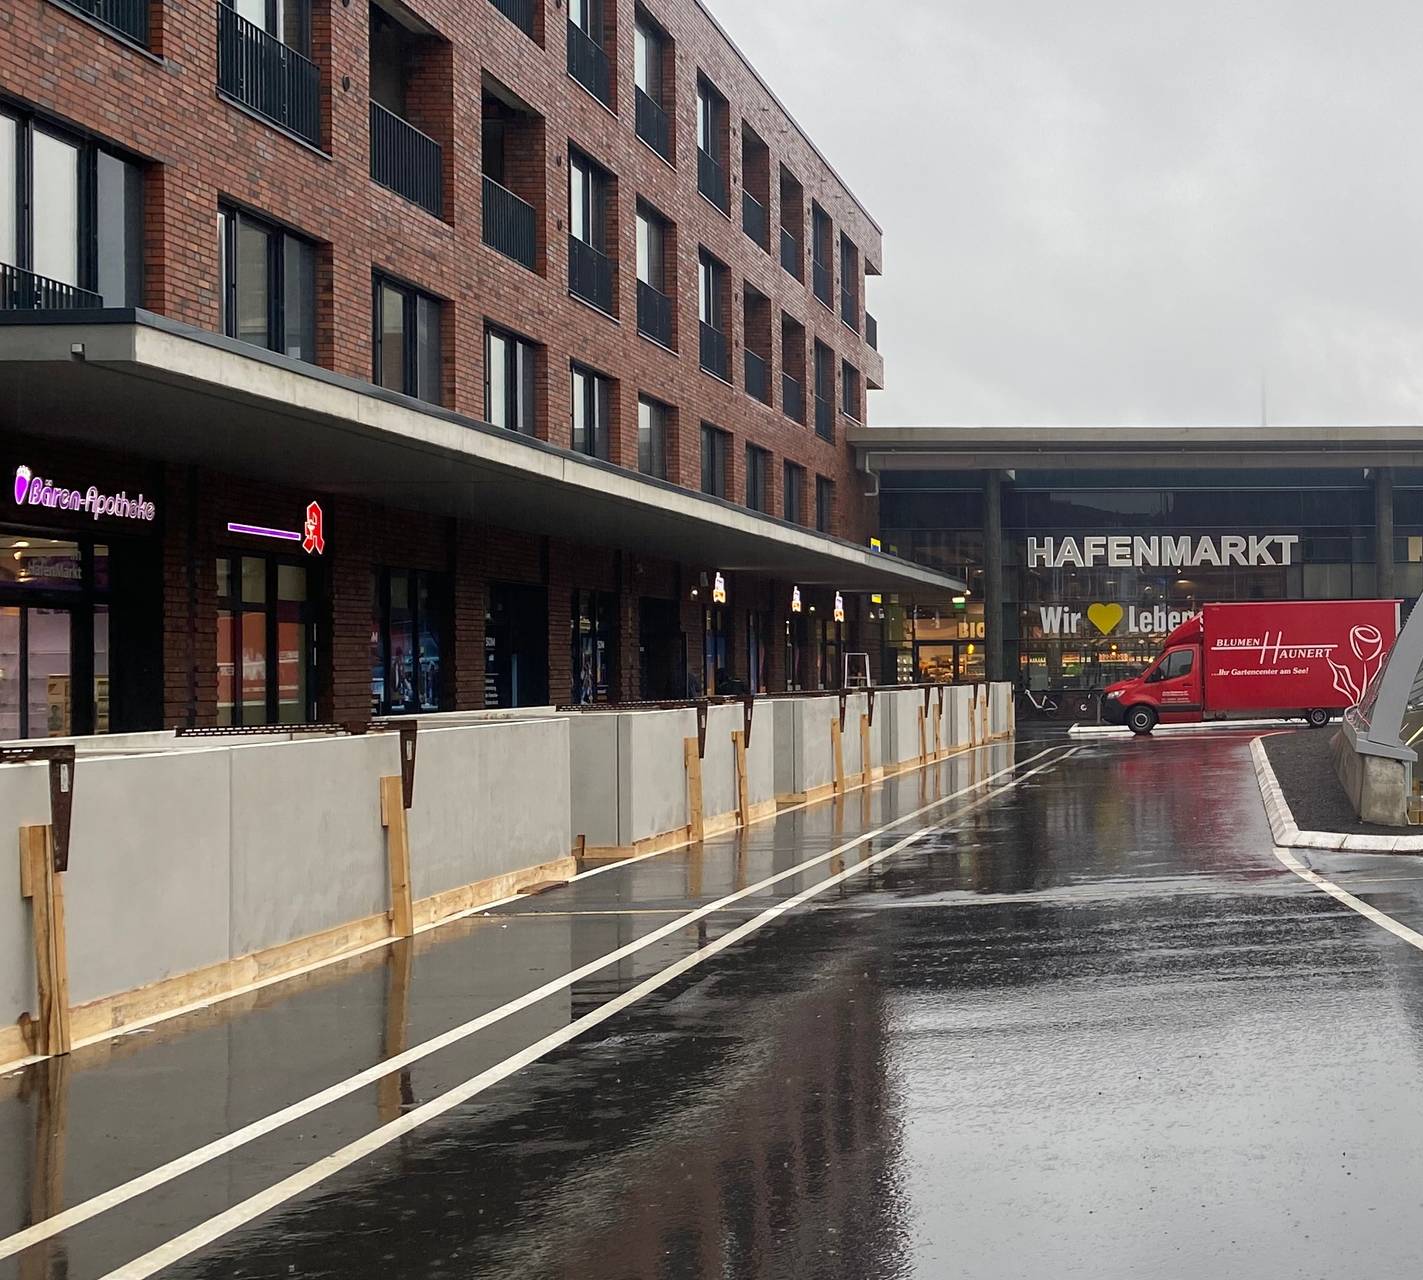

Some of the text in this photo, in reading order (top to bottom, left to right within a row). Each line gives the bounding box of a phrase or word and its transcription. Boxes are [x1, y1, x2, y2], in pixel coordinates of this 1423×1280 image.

[28, 476, 156, 521] Bären-Apotheke
[1026, 534, 1299, 568] HAFENMARKT
[1039, 606, 1081, 634] Wir
[1216, 638, 1260, 647] BLUMEN
[1231, 668, 1278, 676] Gartencenter
[1292, 666, 1309, 674] See!
